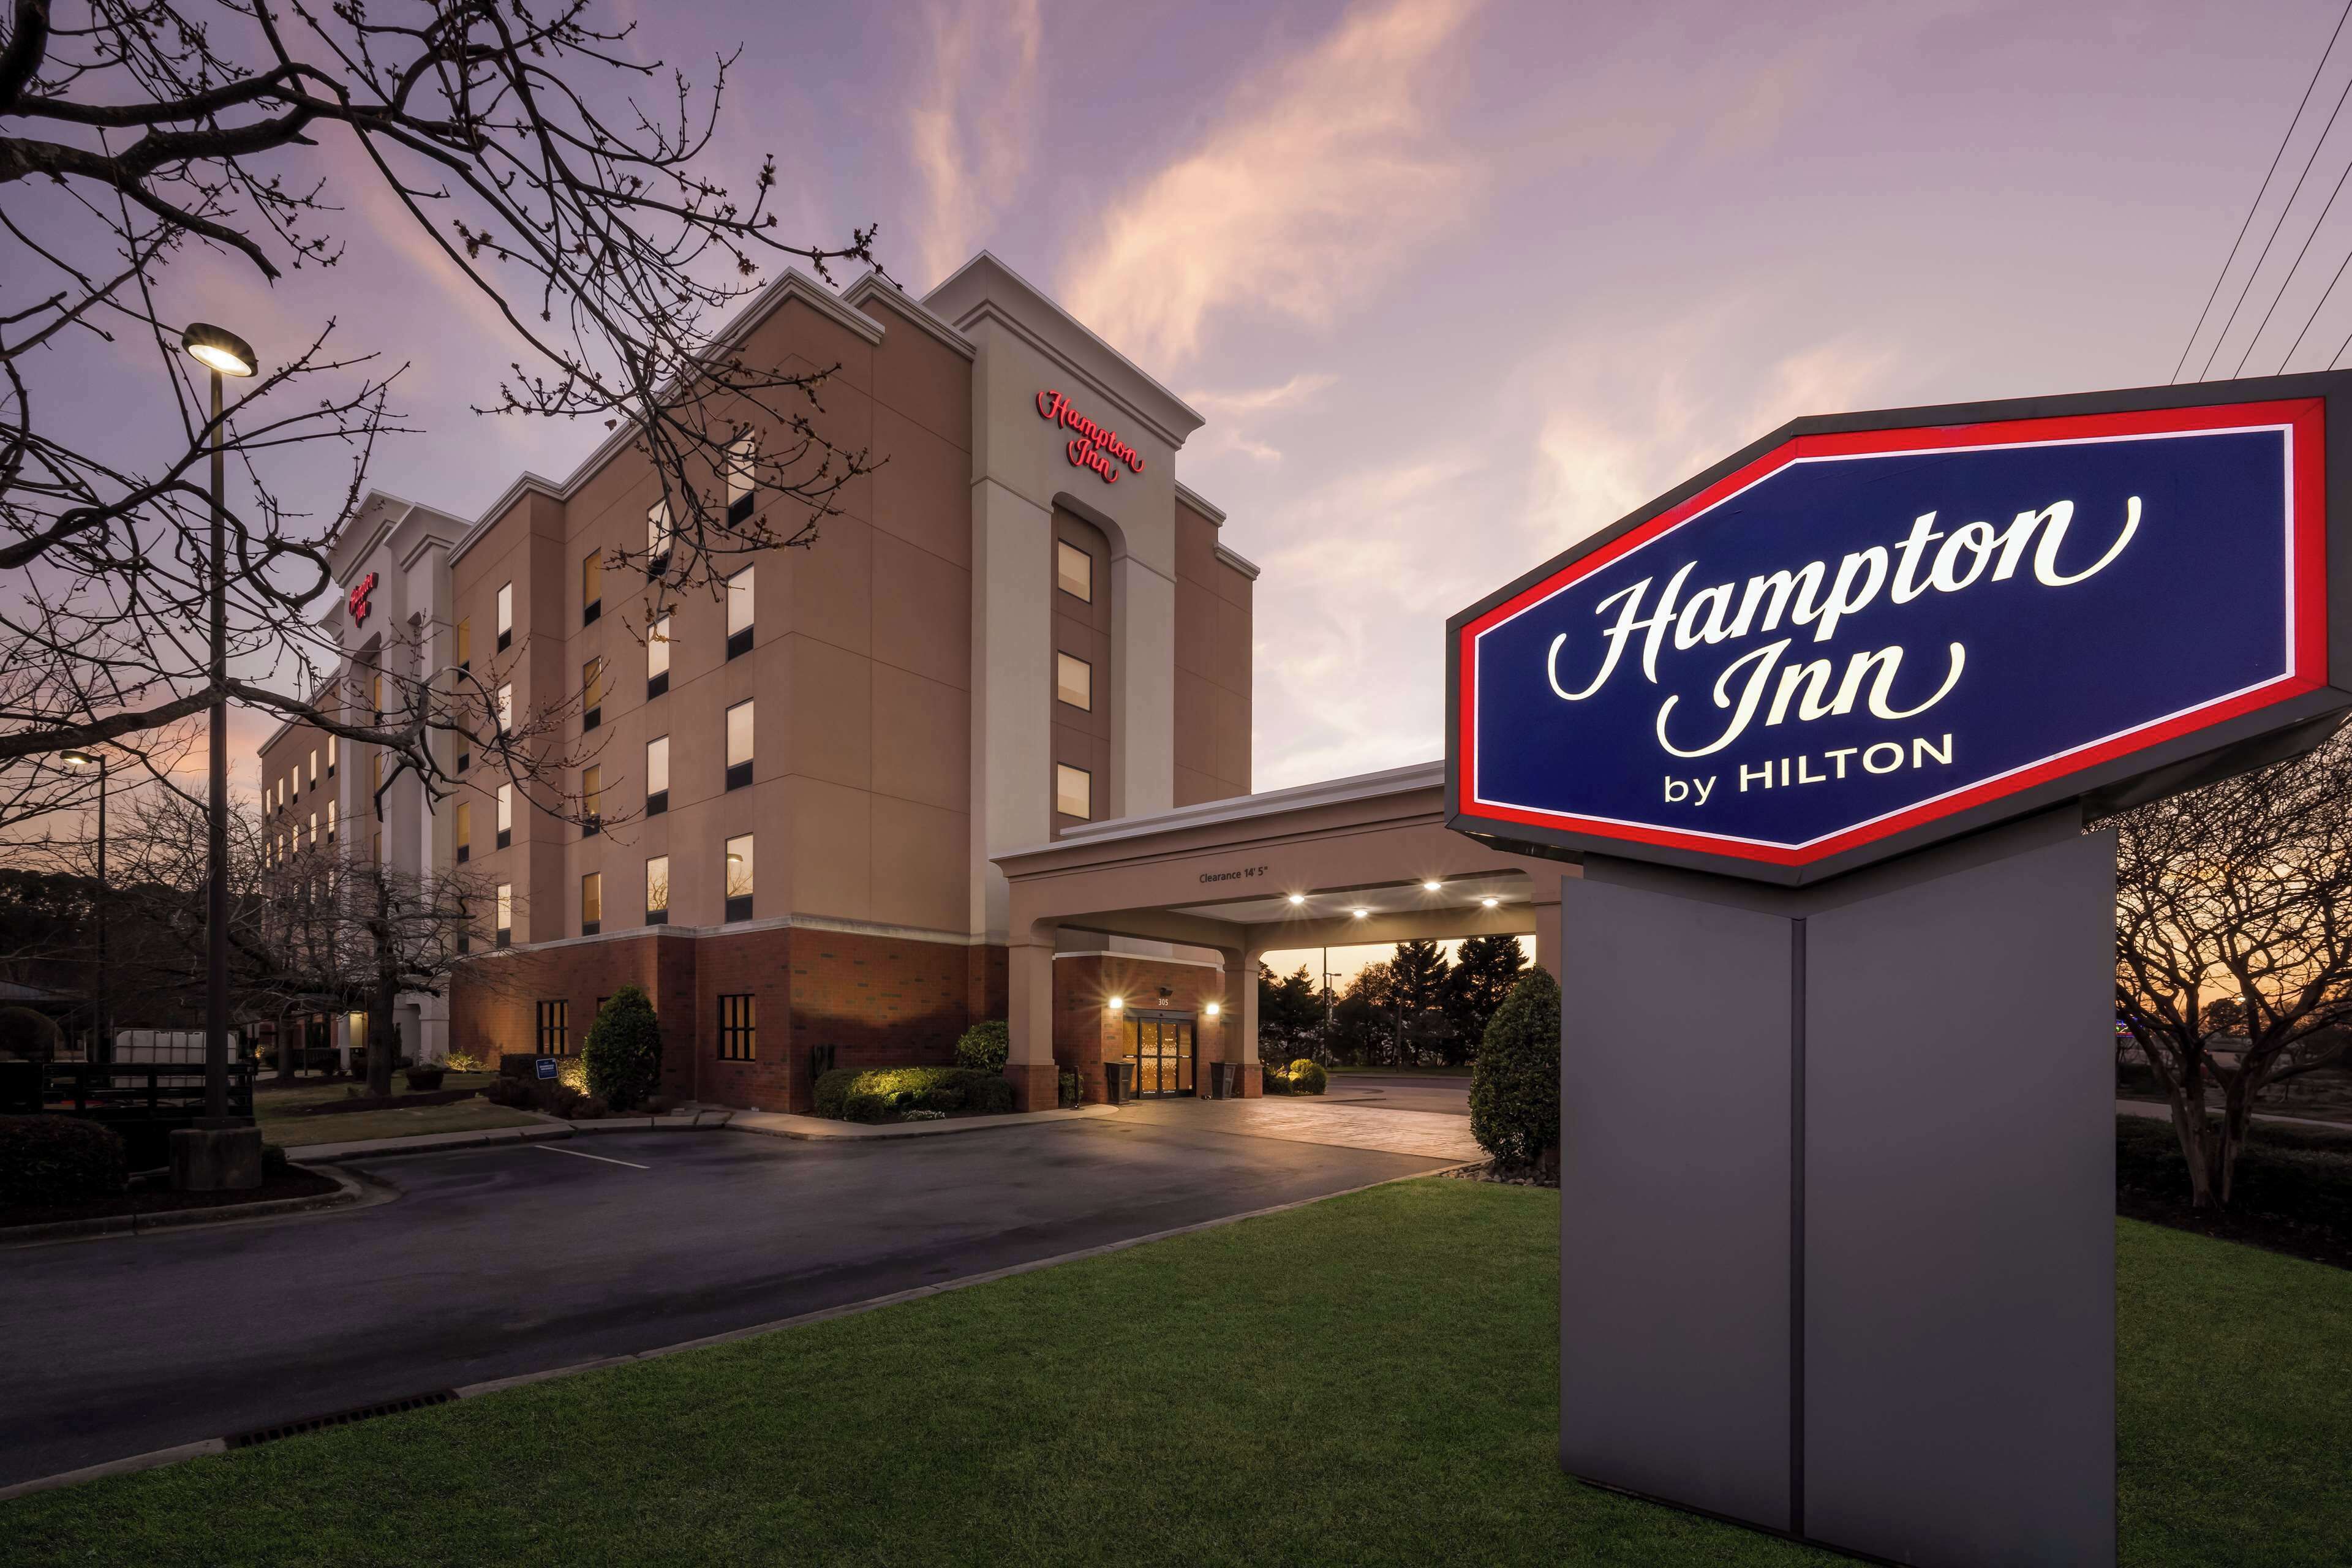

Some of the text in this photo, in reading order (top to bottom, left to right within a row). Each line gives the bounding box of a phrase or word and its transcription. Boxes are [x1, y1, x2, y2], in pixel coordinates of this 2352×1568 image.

[1036, 390, 1145, 473] Hampton
[1067, 440, 1119, 483] Inn
[1548, 496, 2142, 700] Hampton
[1657, 643, 1966, 757] Inn
[1665, 734, 1952, 806] by HILTON
[1199, 872, 1241, 883] Clearance
